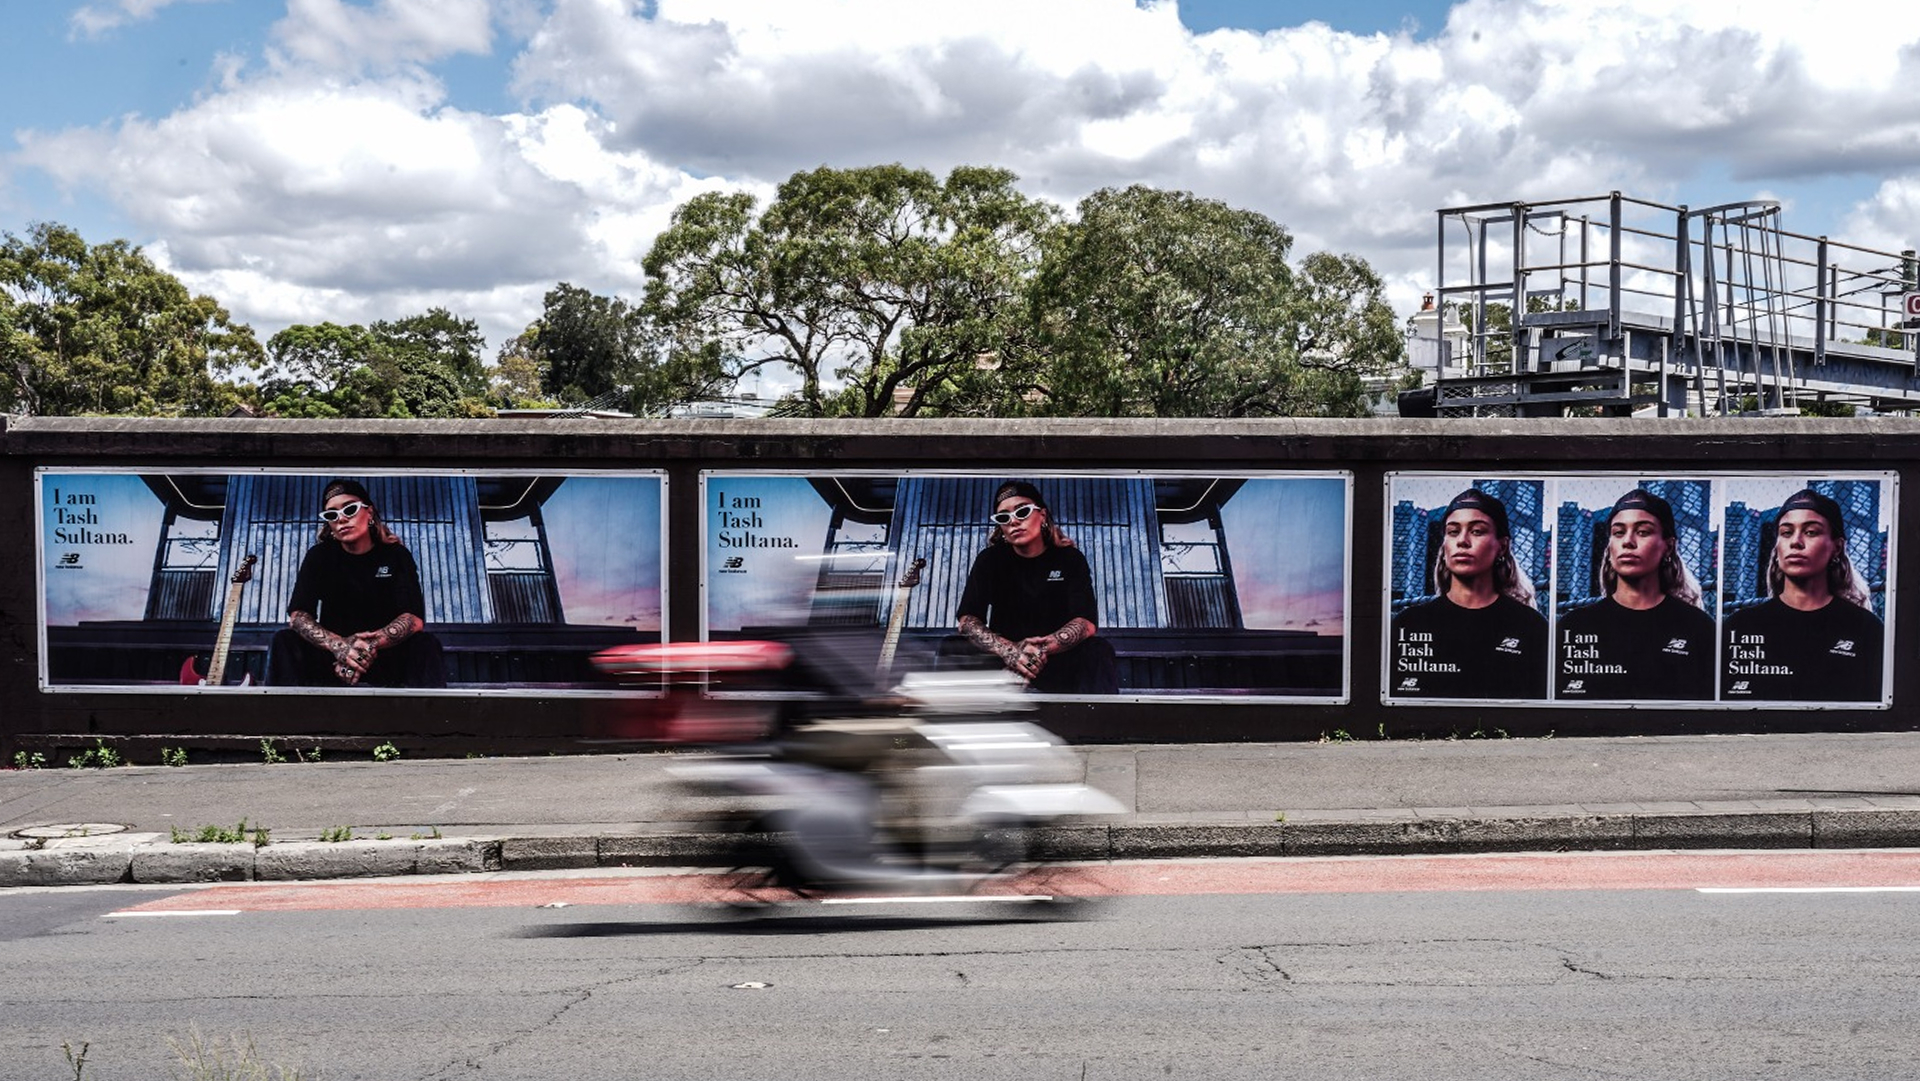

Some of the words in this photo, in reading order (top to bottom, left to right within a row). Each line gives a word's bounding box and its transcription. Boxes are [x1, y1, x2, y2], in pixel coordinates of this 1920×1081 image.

[54, 488, 60, 505] I
[66, 493, 96, 505] am
[719, 491, 725, 509] I
[732, 497, 761, 509] am
[53, 507, 98, 525] Tash
[718, 511, 763, 529] Tash
[54, 527, 134, 545] Sultana.
[718, 530, 799, 548] Sultana.
[1399, 627, 1405, 642] I
[1409, 632, 1433, 642] am
[1564, 629, 1570, 644] I
[1575, 634, 1598, 644] am
[1730, 630, 1736, 644] I
[1741, 634, 1765, 644] am
[1398, 643, 1433, 657] Tash
[1563, 645, 1600, 659] Tash
[1729, 645, 1766, 660] Tash
[1398, 658, 1461, 672] Sultana.
[1563, 660, 1628, 674] Sultana.
[1728, 660, 1794, 675] Sultana.
